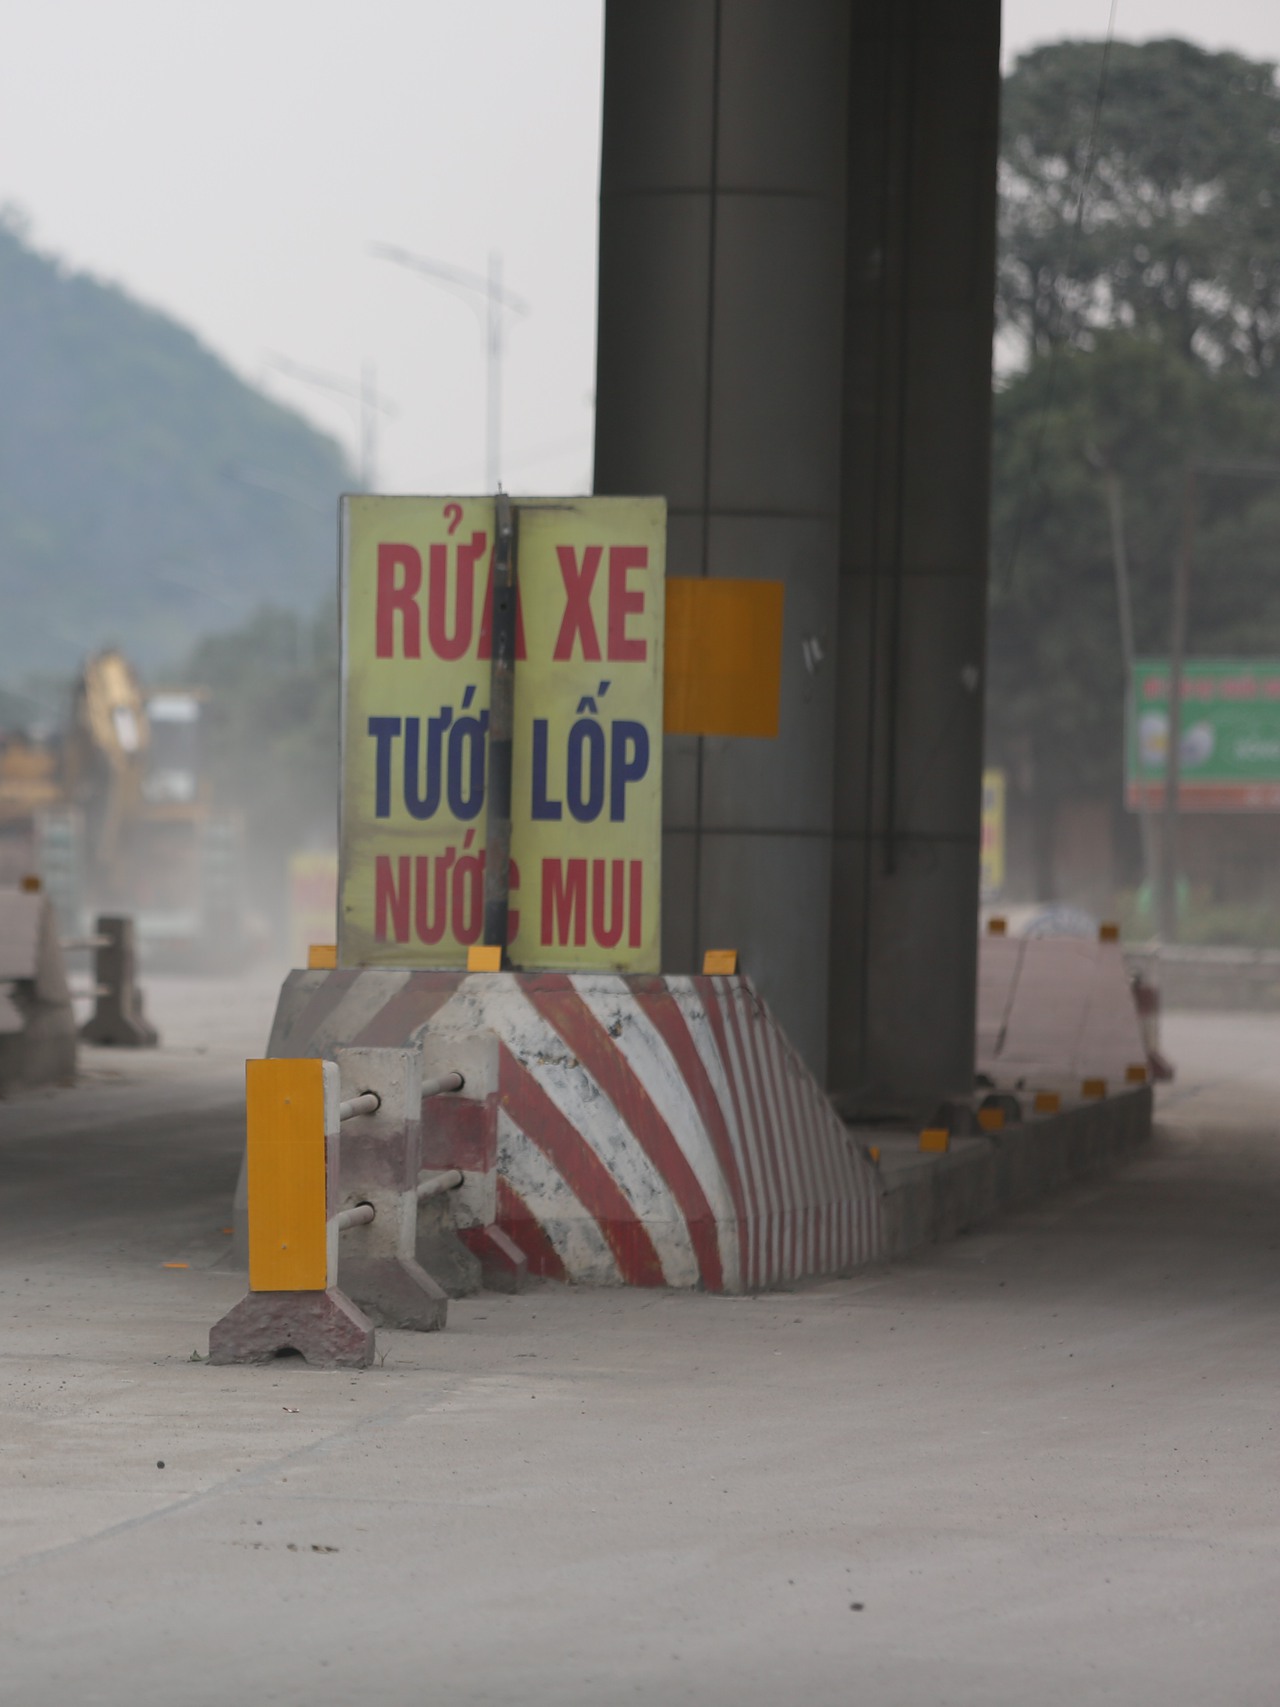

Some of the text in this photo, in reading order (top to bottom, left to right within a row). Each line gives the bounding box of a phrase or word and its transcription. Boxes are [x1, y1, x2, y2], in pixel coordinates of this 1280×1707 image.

[552, 545, 648, 662] XE
[368, 680, 650, 823] TƯỚ LỐP
[540, 858, 642, 949] MUI
